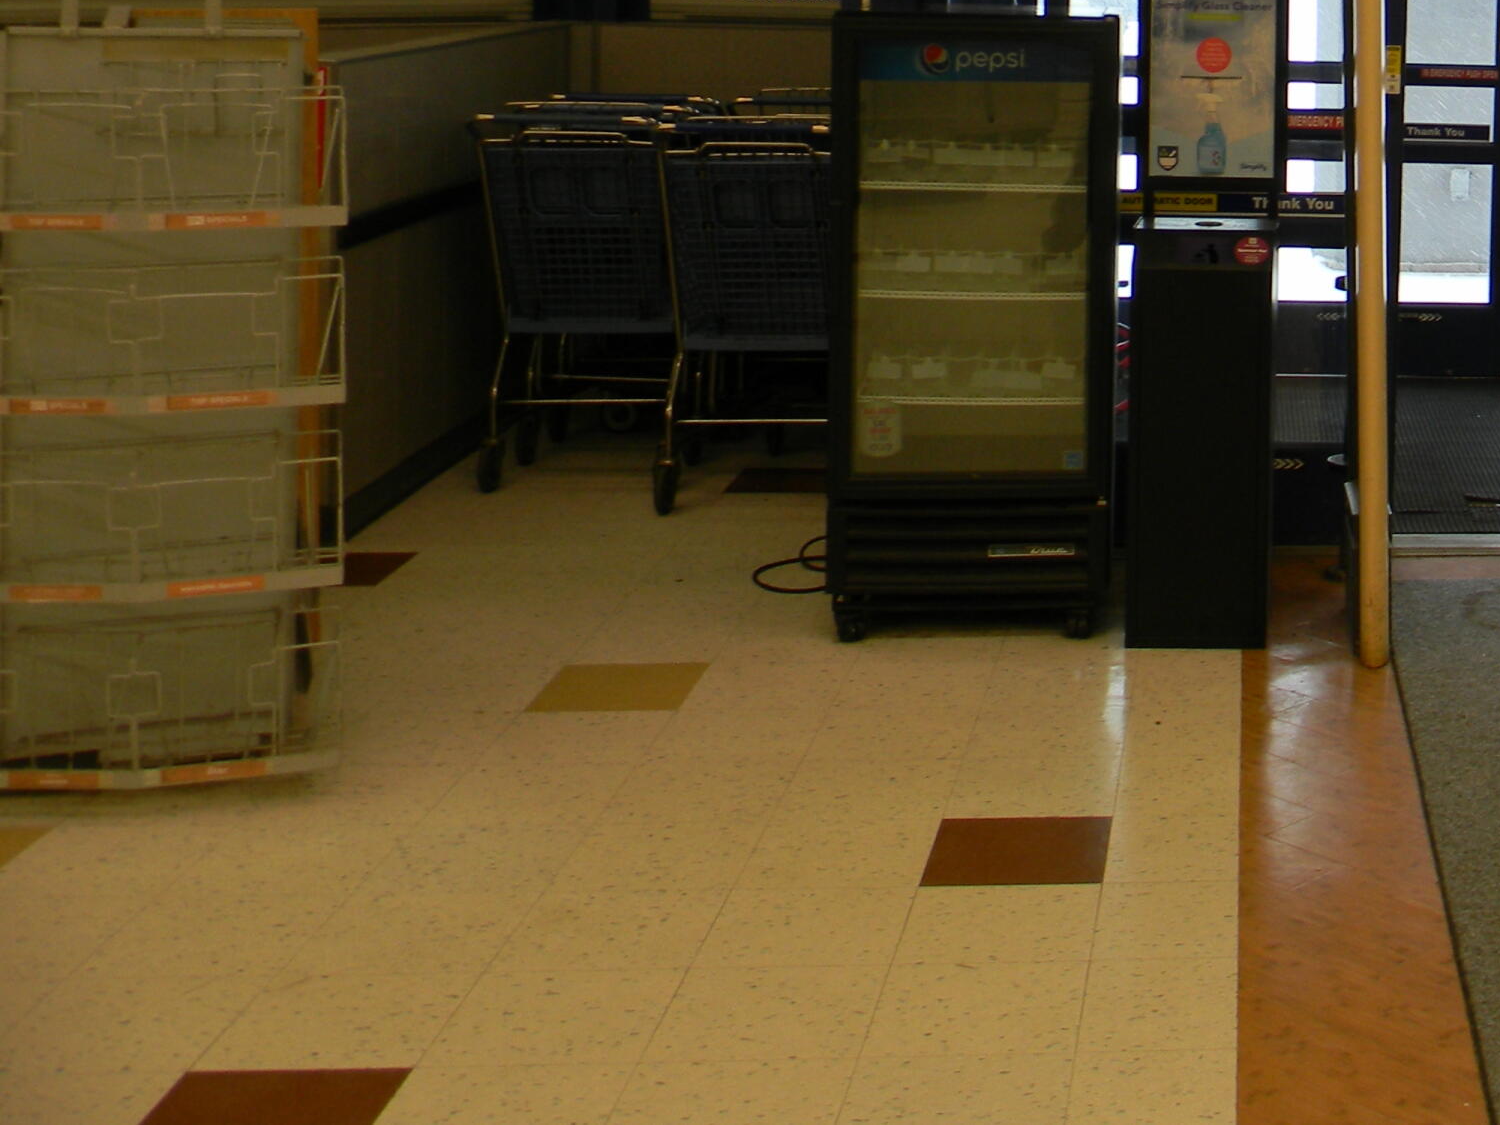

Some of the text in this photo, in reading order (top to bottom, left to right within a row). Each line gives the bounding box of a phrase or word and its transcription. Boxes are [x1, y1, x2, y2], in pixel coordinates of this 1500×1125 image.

[1201, 1, 1229, 11] Glass
[1232, 1, 1273, 12] Cleaner
[955, 48, 1026, 73] pepsi
[1407, 126, 1465, 137] Thank You
[1184, 197, 1214, 206] DOOR
[1251, 196, 1301, 210] Thnk
[1305, 197, 1335, 211] You
